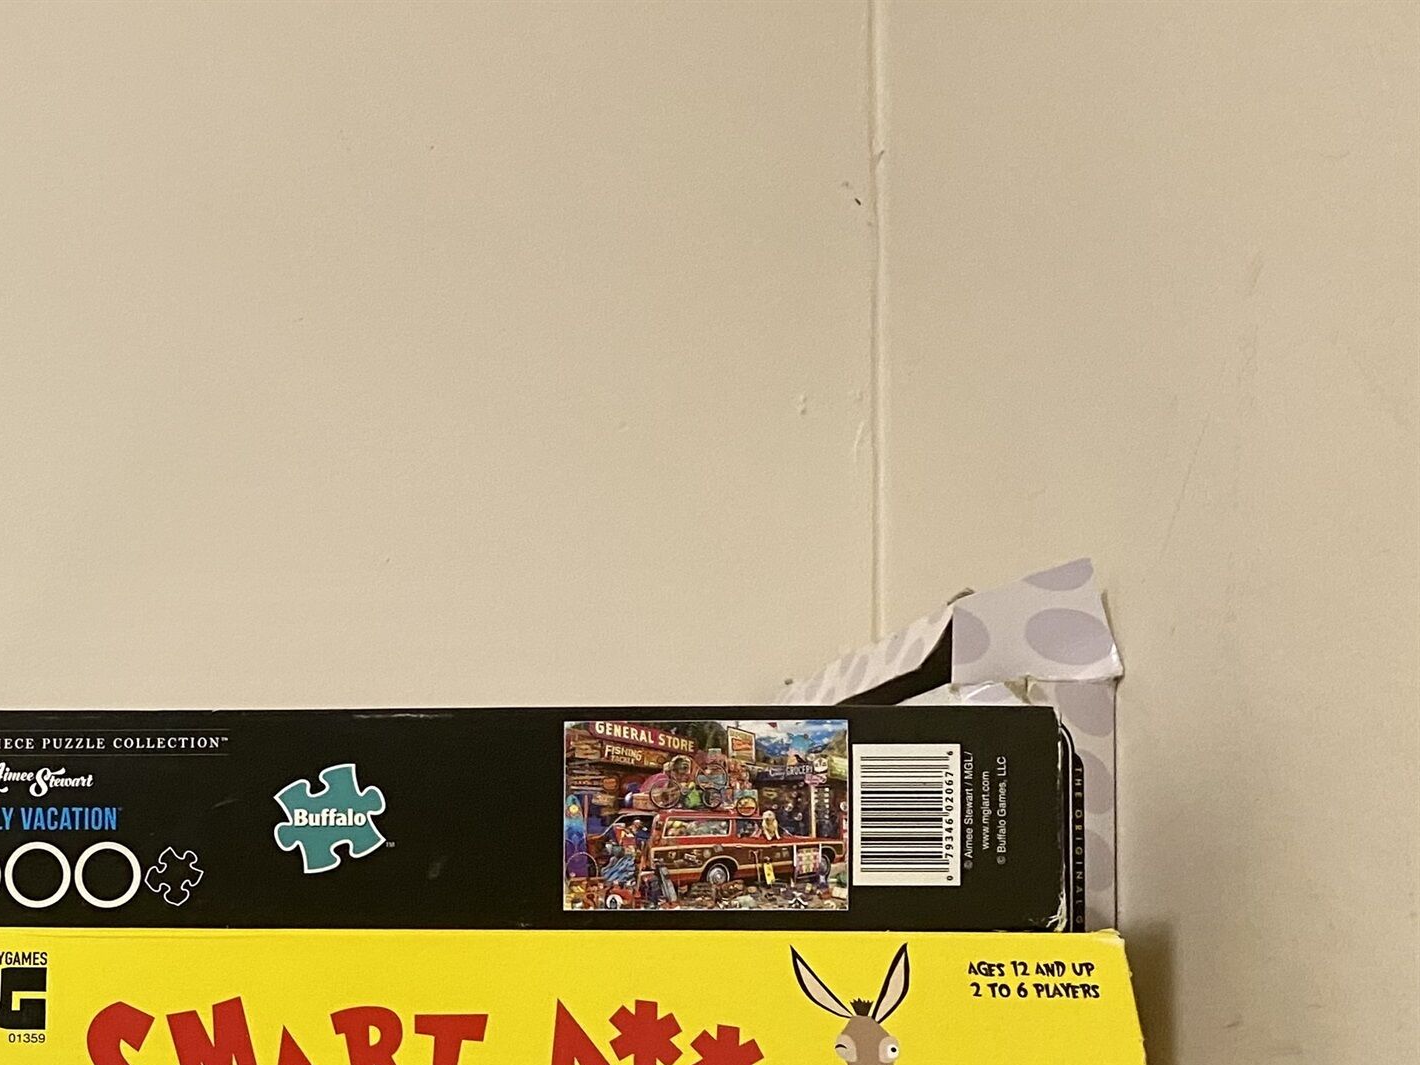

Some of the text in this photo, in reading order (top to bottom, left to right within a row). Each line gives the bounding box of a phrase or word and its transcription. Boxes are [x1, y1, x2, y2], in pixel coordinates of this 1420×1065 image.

[41, 737, 106, 750] PUZZLE
[594, 721, 695, 752] GENERAL STORE
[605, 744, 642, 761] FISHING
[997, 756, 1007, 776] LLC
[29, 766, 94, 797] Stewart
[293, 808, 367, 827] Buffalo
[945, 771, 954, 859] 79346 02067
[981, 771, 991, 850] www.mglart.com
[964, 788, 973, 859] Aimee Stewart
[997, 820, 1007, 853] Buffalo
[968, 960, 1096, 977] AGES 12 AND UP
[970, 982, 1100, 999] 2 TO 6 PLAYERS
[8, 1033, 46, 1044] 01359
